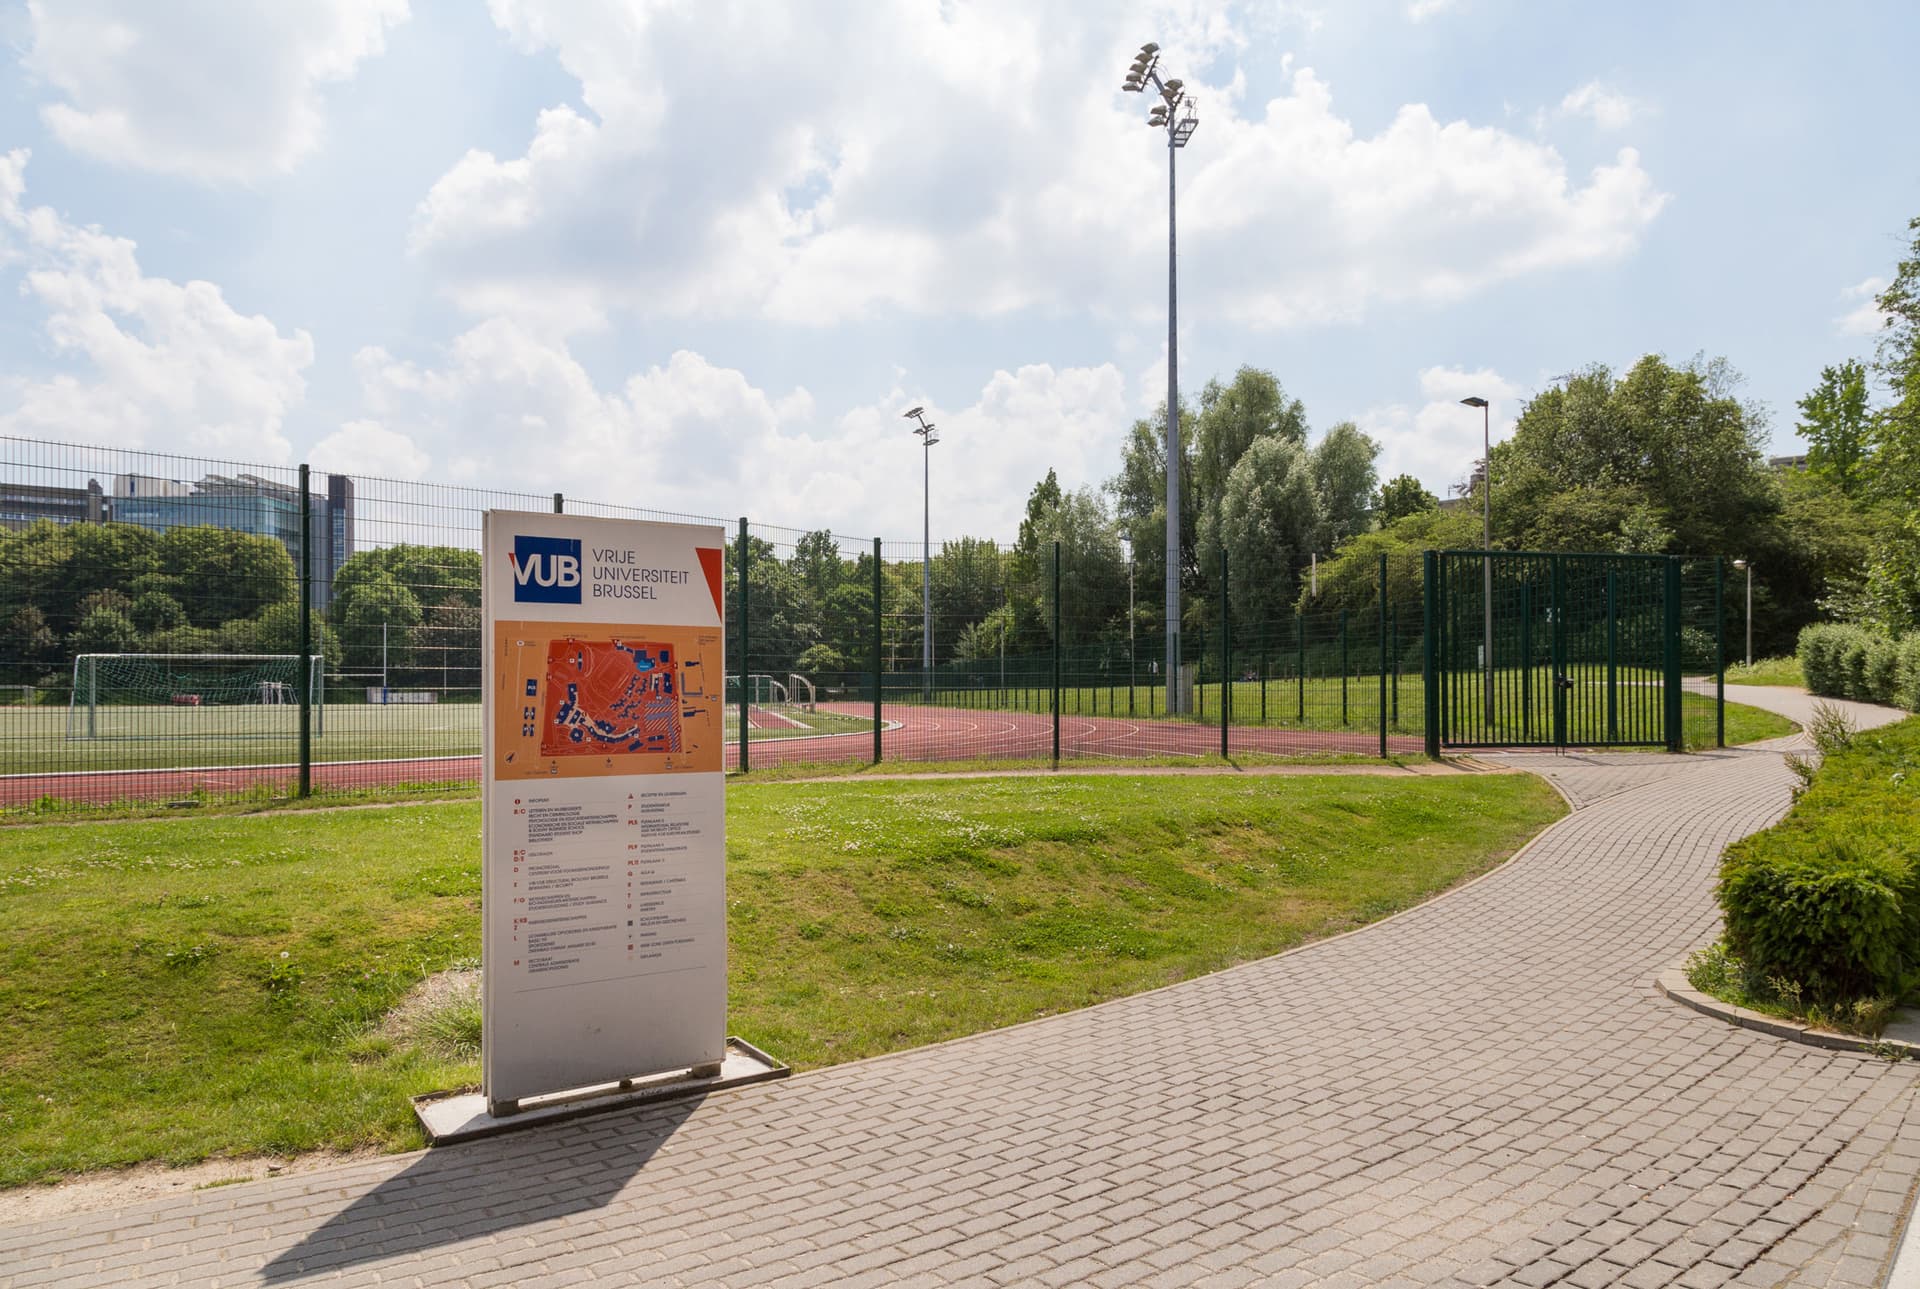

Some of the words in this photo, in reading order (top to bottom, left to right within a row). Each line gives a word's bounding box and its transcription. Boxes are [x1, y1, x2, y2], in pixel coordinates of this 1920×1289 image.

[592, 548, 635, 564] VRIJE
[511, 553, 580, 587] VUB
[592, 566, 689, 585] UNIVERSITEIT
[592, 583, 657, 600] BRUSSEL
